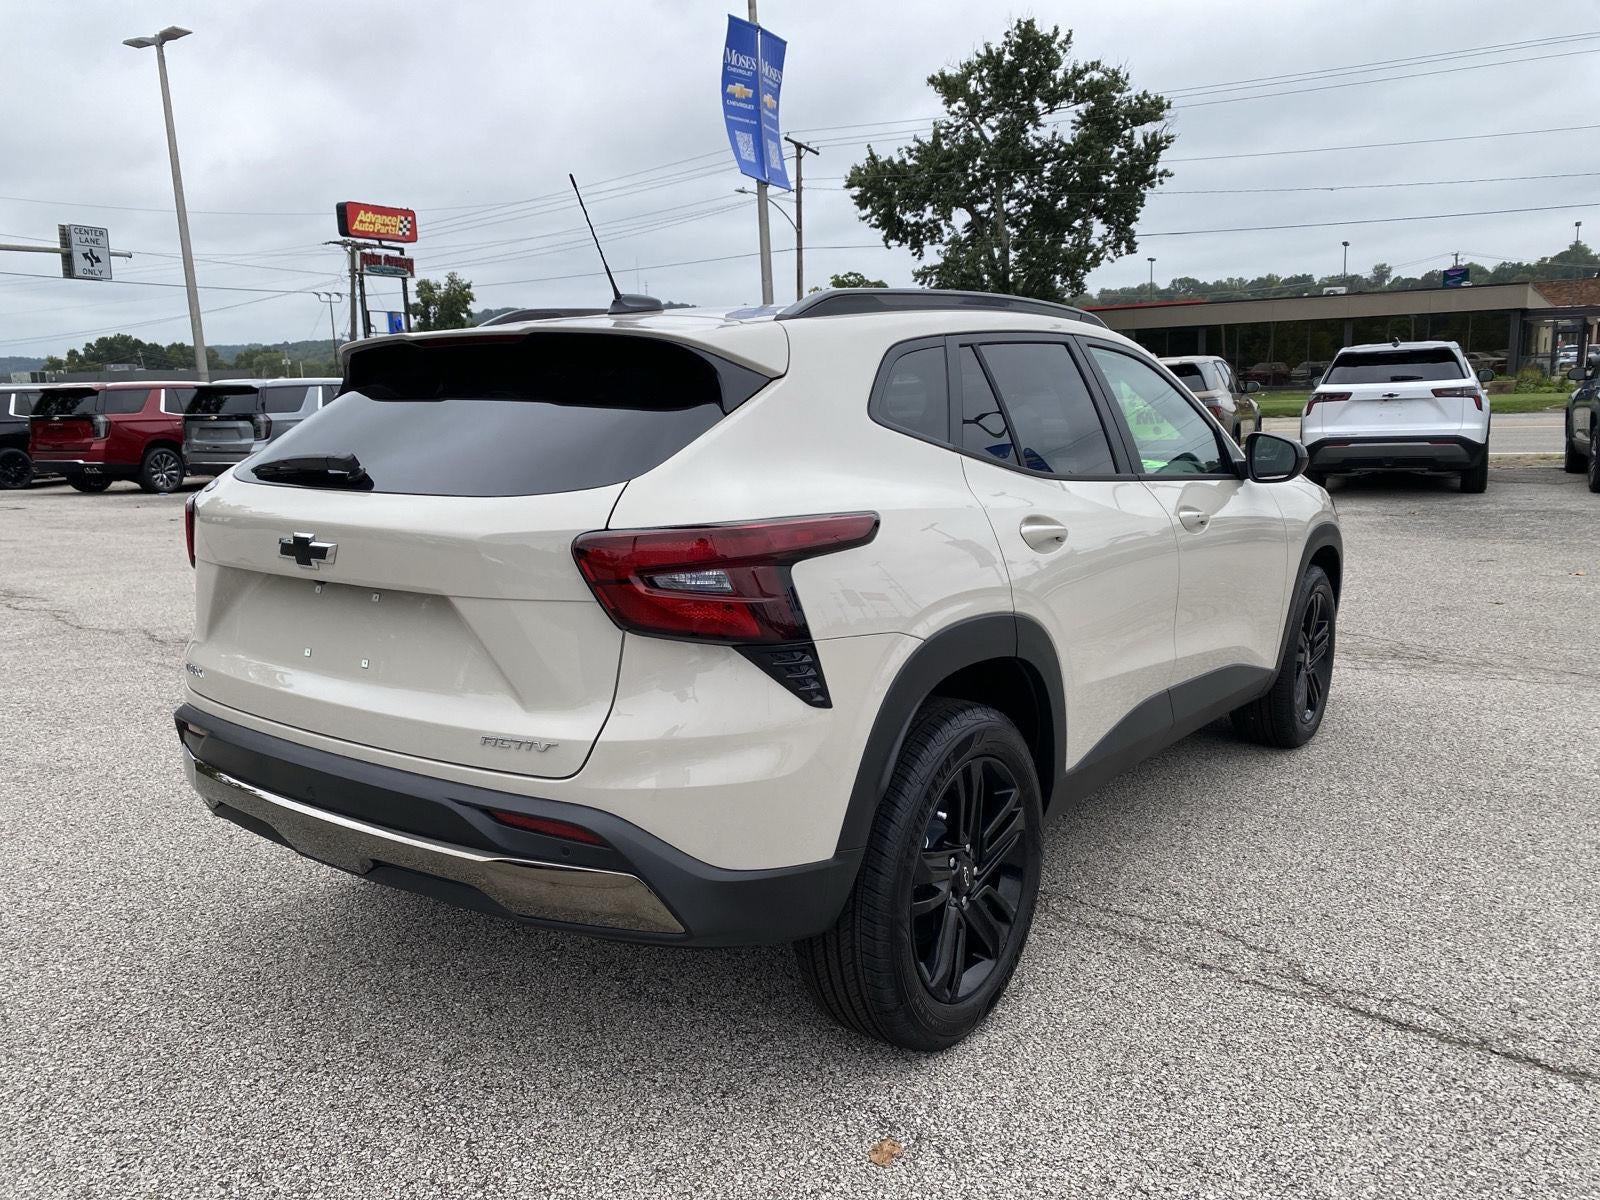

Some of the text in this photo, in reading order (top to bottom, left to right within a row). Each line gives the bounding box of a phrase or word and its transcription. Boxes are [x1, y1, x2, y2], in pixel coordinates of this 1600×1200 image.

[725, 47, 757, 71] MOSES
[357, 210, 397, 225] Advance
[74, 227, 104, 237] CENTER
[352, 221, 397, 234] Auto Parts
[79, 236, 101, 245] LANE
[82, 267, 103, 276] ONLY
